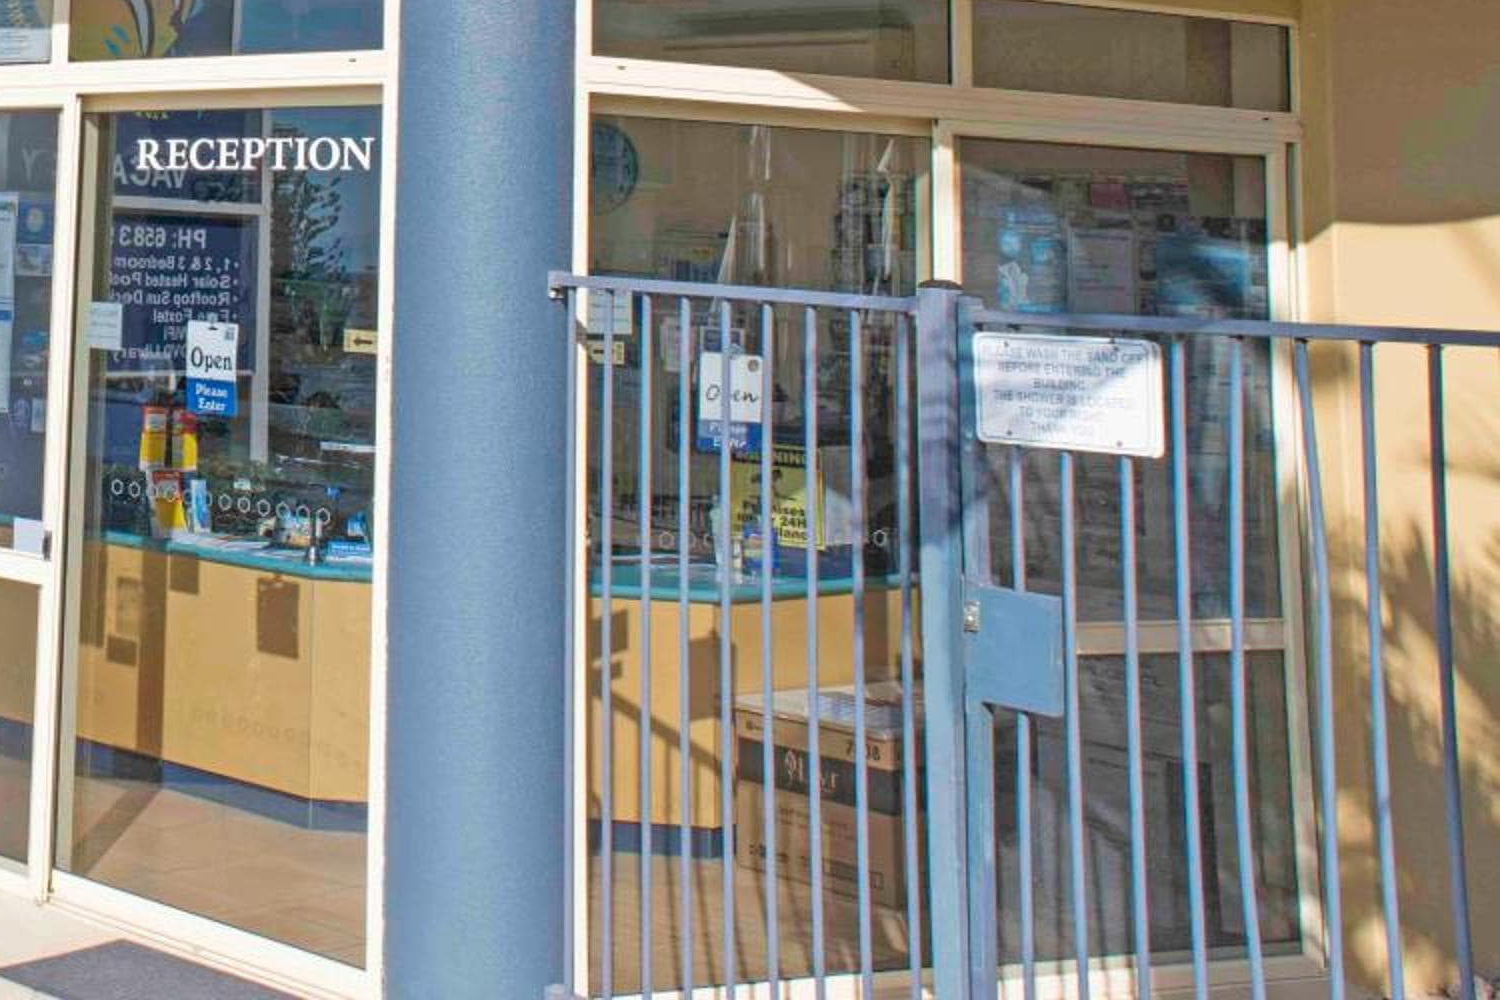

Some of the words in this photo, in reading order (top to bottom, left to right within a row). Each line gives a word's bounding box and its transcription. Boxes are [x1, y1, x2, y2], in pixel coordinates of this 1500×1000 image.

[137, 137, 375, 172] RECEPTION
[191, 346, 232, 373] Open
[706, 384, 758, 403] Oen
